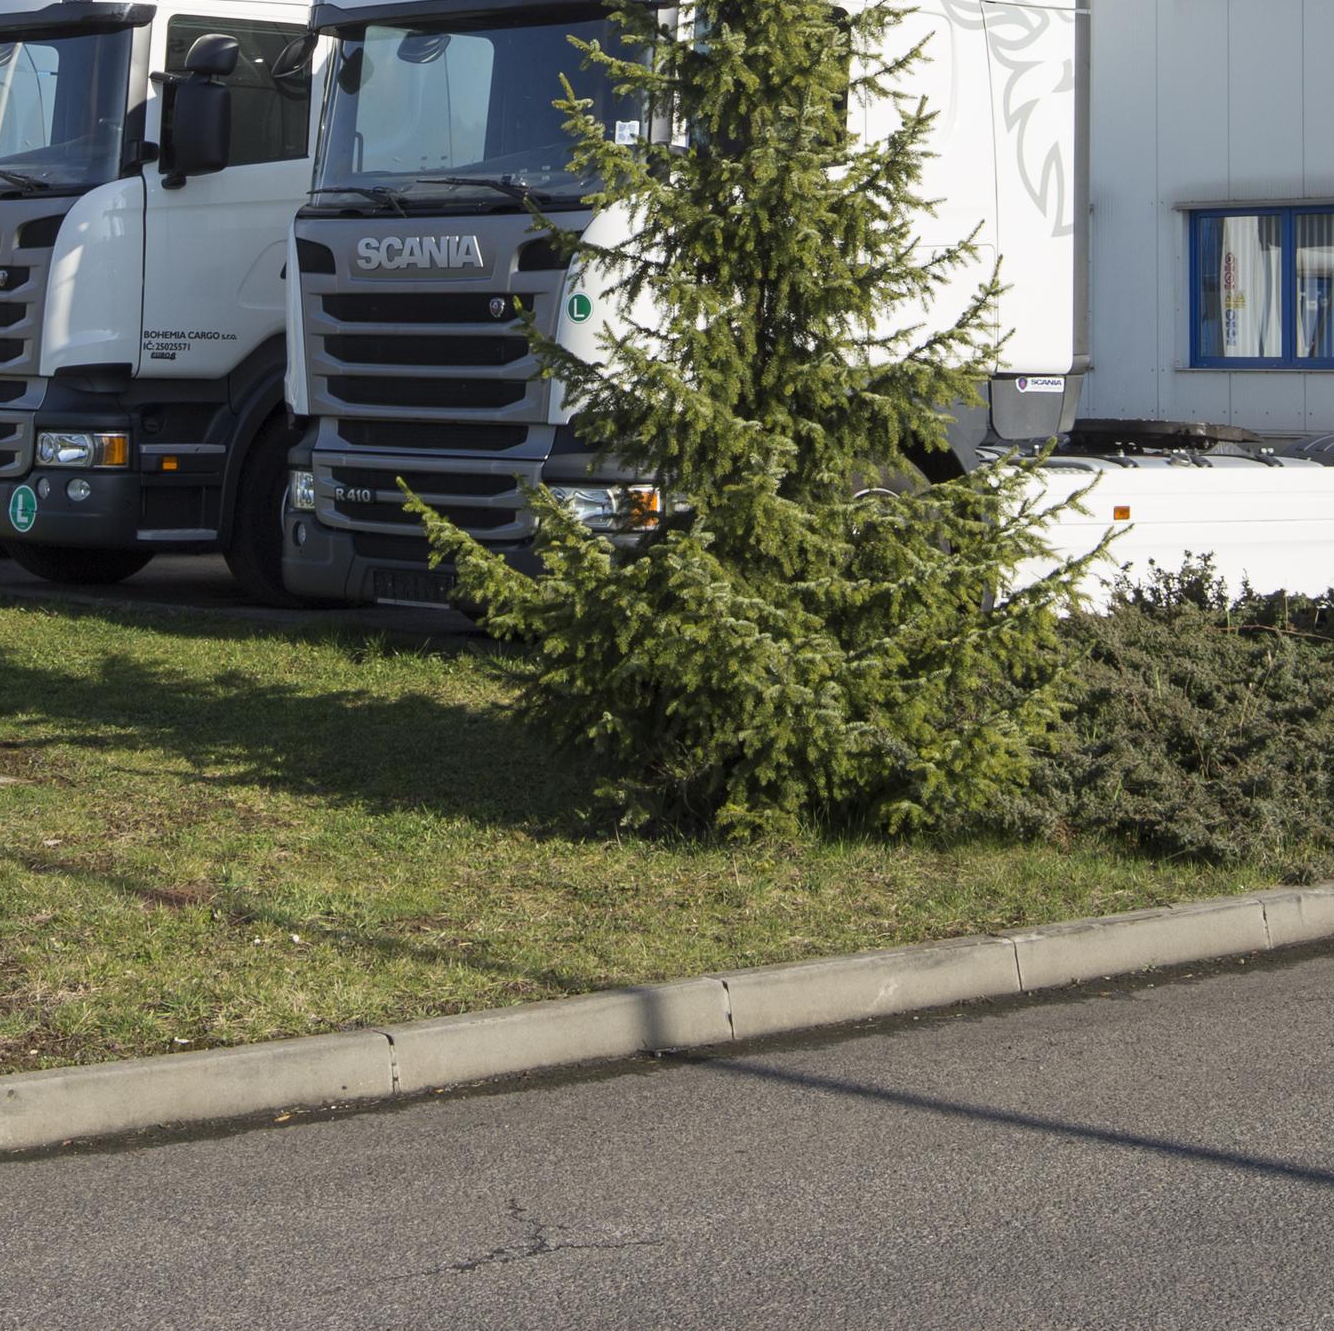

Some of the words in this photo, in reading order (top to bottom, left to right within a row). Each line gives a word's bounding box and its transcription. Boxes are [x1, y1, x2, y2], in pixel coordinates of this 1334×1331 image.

[356, 235, 484, 270] SCANIA
[143, 331, 186, 339] BOHEMIA
[187, 331, 220, 340] CARGO
[335, 488, 346, 501] R
[347, 489, 371, 502] 410
